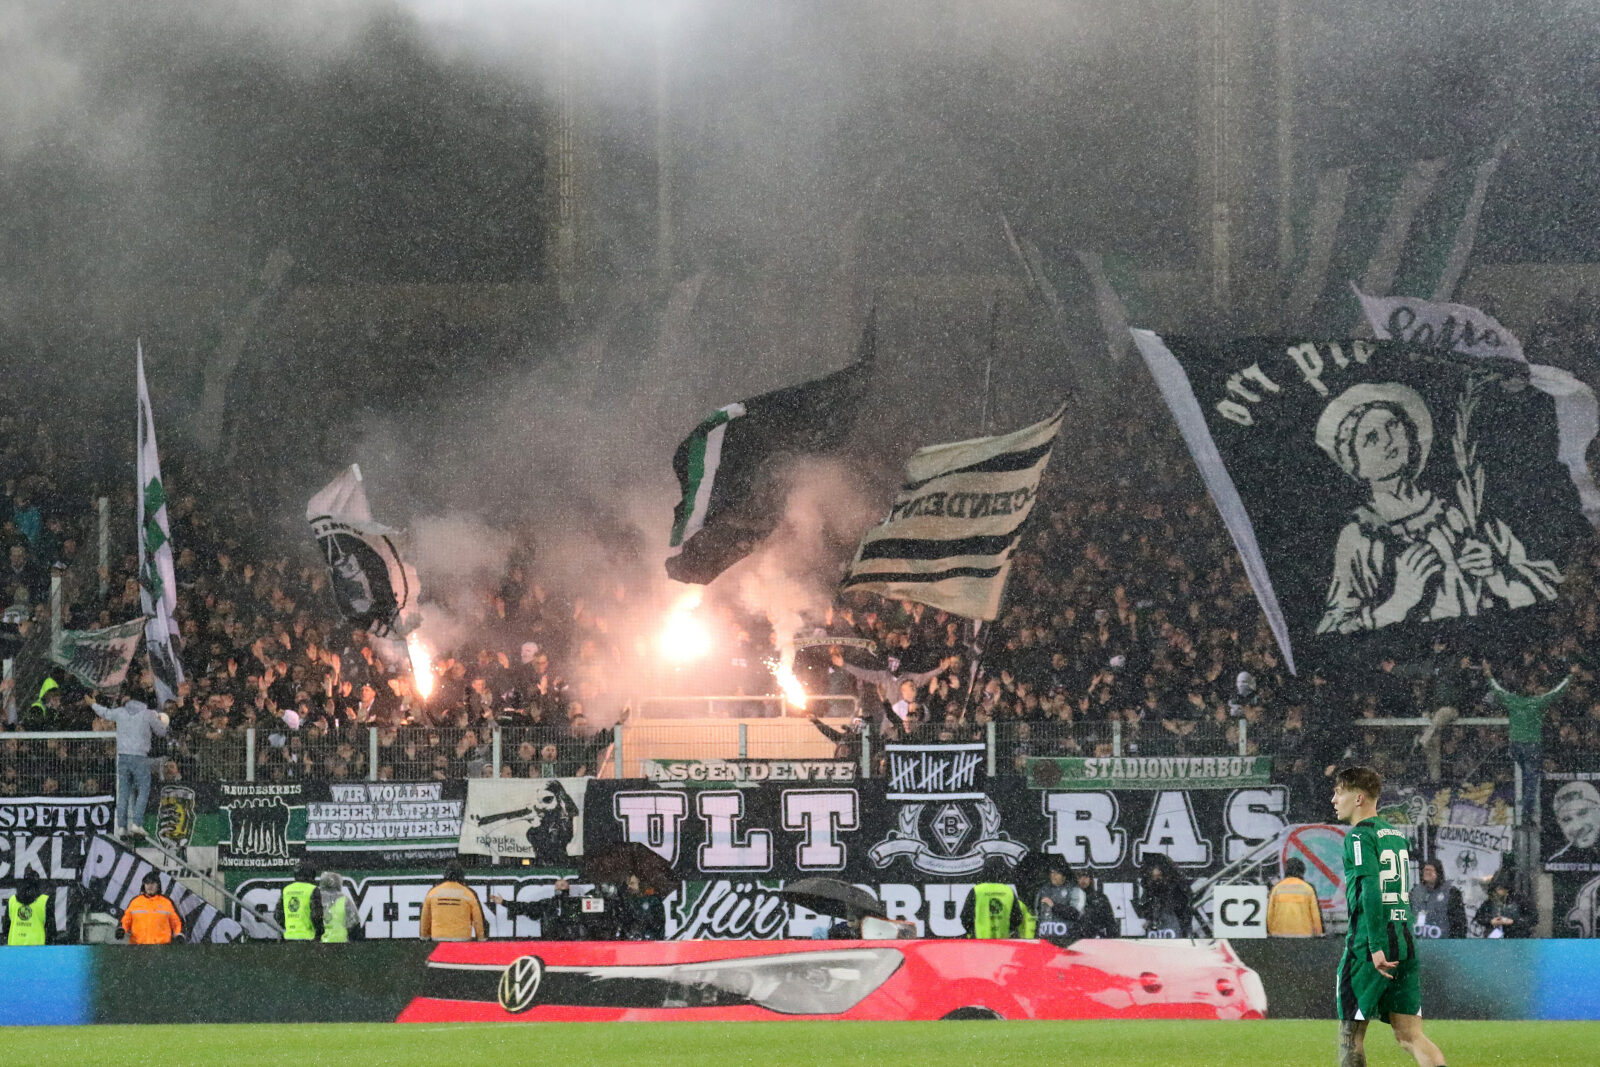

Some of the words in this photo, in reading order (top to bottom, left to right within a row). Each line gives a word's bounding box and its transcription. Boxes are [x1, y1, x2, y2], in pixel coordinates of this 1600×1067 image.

[650, 761, 856, 782] ASCENDENTE
[1084, 757, 1257, 779] STADIONVERBOT
[220, 784, 302, 796] REUNDESKREIS
[330, 784, 366, 802] WIR
[367, 783, 441, 801] WOLLEN
[307, 803, 374, 820] LIEBER
[306, 821, 342, 839] ALS
[344, 819, 462, 838] DISKUTIEREN
[477, 835, 515, 846] rabauke
[498, 844, 536, 853] bleiben
[219, 856, 300, 867] ÖNCHENGLADBAC
[1379, 849, 1410, 905] 20
[1219, 898, 1260, 927] C2
[1390, 908, 1408, 921] NETZ
[498, 956, 541, 1011] VW
